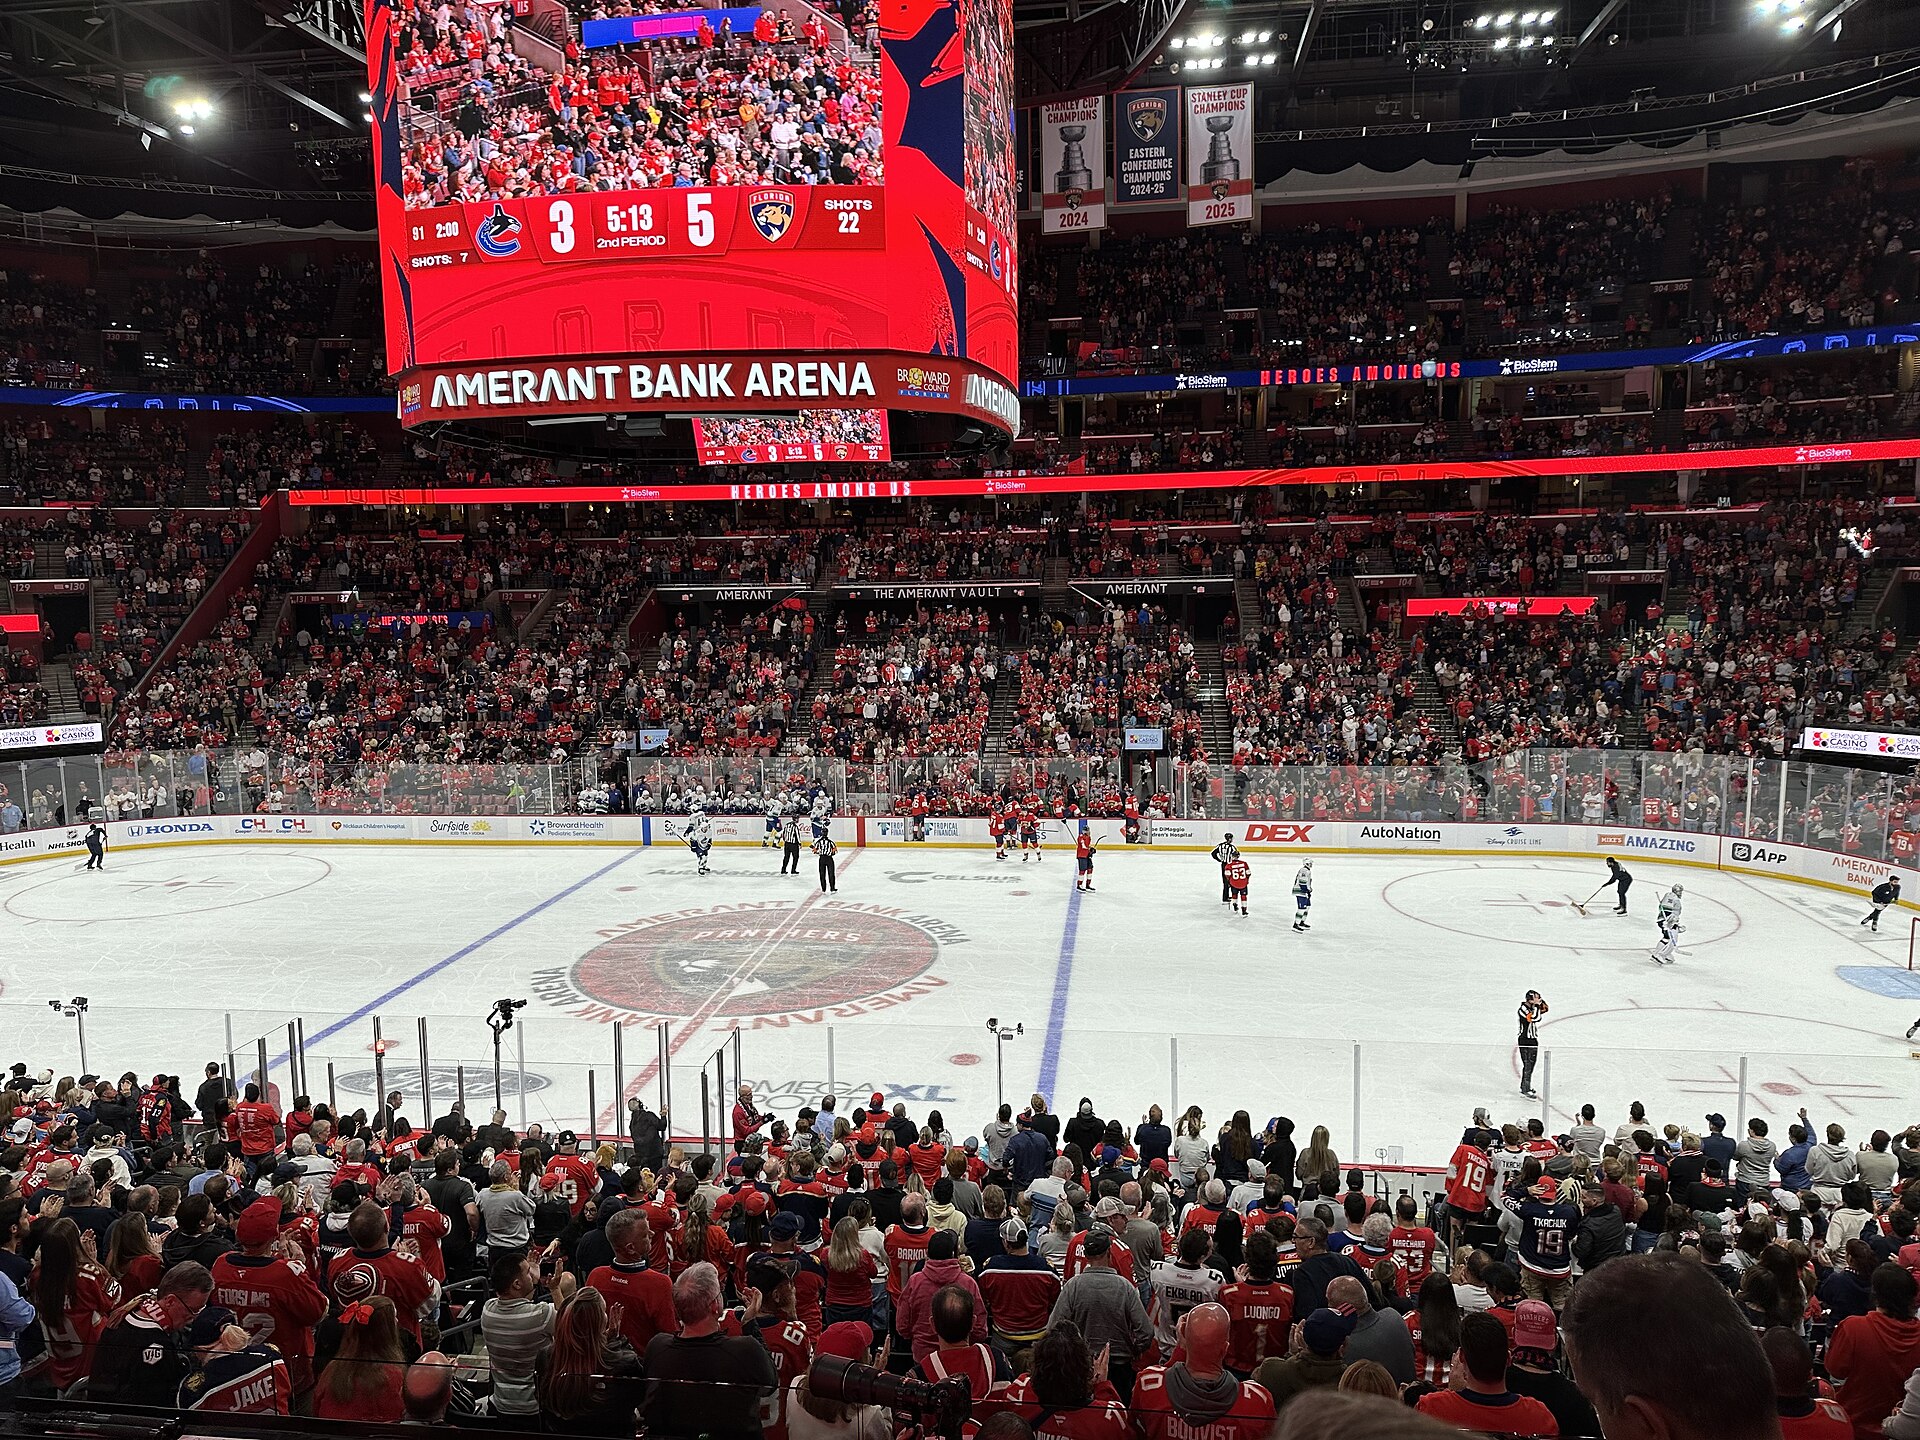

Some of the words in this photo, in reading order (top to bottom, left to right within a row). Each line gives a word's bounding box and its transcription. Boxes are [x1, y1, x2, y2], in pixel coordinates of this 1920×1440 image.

[517, 1, 529, 13] 115
[1191, 90, 1228, 103] STANLEY
[1230, 88, 1248, 100] CUP
[1045, 100, 1080, 112] STANLEY
[1082, 97, 1100, 109] CUP
[1132, 102, 1162, 111] FLORIDA
[1193, 100, 1246, 114] CHAMPIONS
[1047, 110, 1098, 123] CHAMPIONS
[1129, 146, 1165, 159] EASTERN
[1121, 158, 1173, 172] CONFERENCE
[1123, 170, 1172, 184] CHAMPIONS
[1130, 183, 1165, 196] 2024-25
[753, 193, 790, 203] FLORIDA
[824, 198, 873, 212] SHOTS
[1205, 202, 1235, 220] 2025
[606, 202, 653, 233] 5:13
[686, 192, 715, 247] 5
[837, 212, 860, 234] 22
[1059, 212, 1089, 228] 2024
[412, 226, 425, 241] 91
[435, 221, 459, 239] 2:00
[549, 200, 575, 254] 3
[596, 236, 619, 249] 2nd
[621, 234, 667, 247] PERIOD
[411, 255, 452, 269] SHOTS:
[460, 252, 469, 264] 7
[1514, 358, 1558, 370] BioStem
[897, 367, 950, 385] BROWARD
[1188, 374, 1228, 386] BioStem
[1261, 368, 1338, 385] HEROES
[1352, 364, 1422, 382] AMONG
[1436, 362, 1460, 378] US
[430, 365, 622, 408] AMERANT
[629, 363, 735, 398] BANK
[744, 362, 876, 397] ARENA
[924, 384, 950, 392] COUNTY
[900, 390, 948, 398] FLORIDA
[768, 446, 778, 462] 3
[814, 445, 823, 460] 5
[869, 450, 878, 460] 22
[1810, 448, 1852, 458] BioStem
[731, 484, 800, 499] HEROES
[814, 482, 876, 498] AMONG
[890, 482, 911, 496] US
[995, 481, 1026, 490] BioStem
[631, 489, 660, 497] BioStem
[15, 583, 30, 592] 129
[70, 583, 85, 591] 130
[874, 589, 894, 599] THE
[898, 588, 956, 598] AMERANT
[960, 588, 1001, 597] VAULT
[1106, 584, 1168, 594] AMERANT
[716, 590, 773, 600] AMERANT
[3, 736, 36, 744] CASINO
[62, 731, 94, 739] CASINO
[1830, 739, 1867, 748] CASINO
[1645, 805, 1658, 815] 63
[146, 823, 214, 834] HONDA
[242, 819, 266, 829] CH
[282, 819, 305, 829] CH
[430, 820, 470, 832] Surfside
[580, 820, 604, 828] Health
[1245, 824, 1315, 842] DEX
[1360, 826, 1440, 839] AutoNation
[0, 838, 35, 850] Health
[1626, 836, 1695, 852] AMAZING
[1832, 857, 1891, 877] AMERANT
[930, 874, 1022, 882] CELSIUS
[1232, 868, 1246, 880] 63
[1847, 873, 1874, 886] BANK
[596, 900, 797, 938] AMERANT
[822, 900, 909, 917] BANK
[901, 915, 971, 946] ARENA
[693, 930, 861, 941] PANTHERS
[724, 1080, 875, 1095] OMEGA
[884, 1084, 957, 1102] XL
[1462, 1162, 1486, 1193] 19
[1533, 1217, 1567, 1228] TKACHUK
[1392, 1239, 1425, 1249] MARCHAND
[1536, 1229, 1563, 1255] 19
[218, 1288, 270, 1308] FORSLING
[1165, 1285, 1202, 1302] EKBLAD
[1244, 1305, 1280, 1320] LUONGO
[1252, 1323, 1269, 1361] 1
[229, 1375, 274, 1412] JAKE
